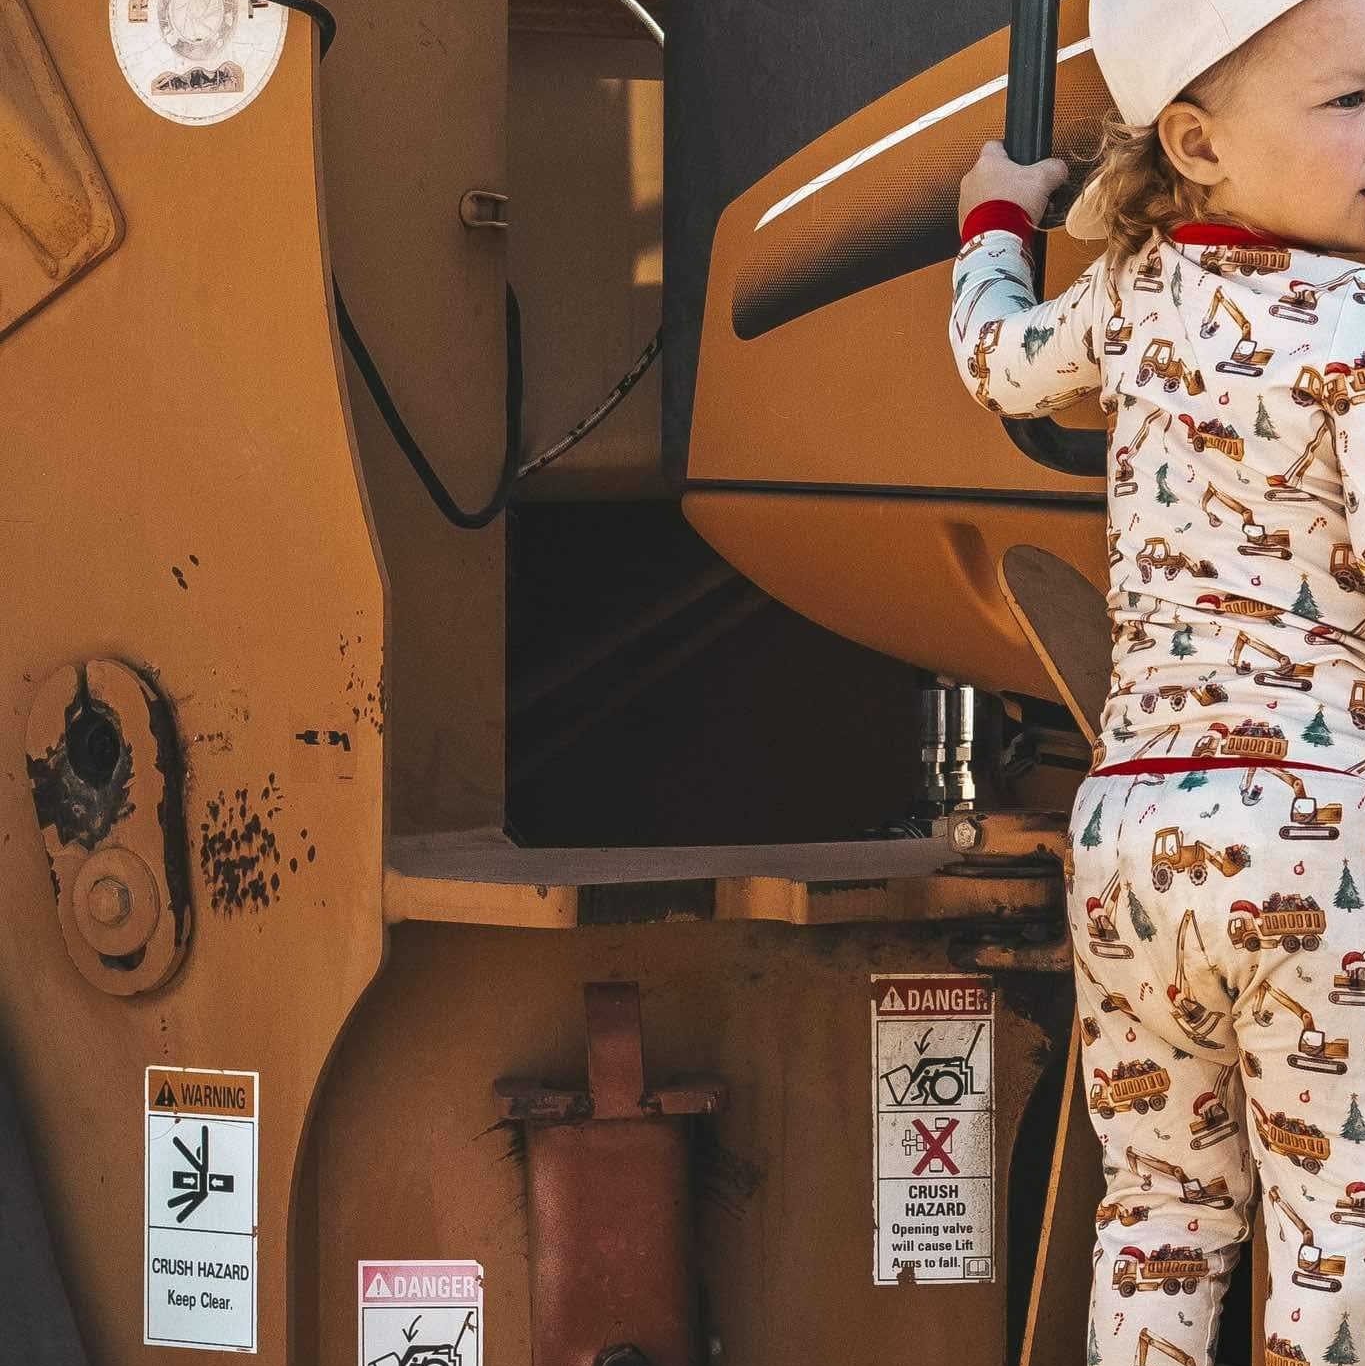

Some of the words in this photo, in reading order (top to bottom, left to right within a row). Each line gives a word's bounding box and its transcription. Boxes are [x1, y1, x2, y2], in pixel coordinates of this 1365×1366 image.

[907, 988, 988, 1011] DANGER
[181, 1083, 246, 1110] WARNING
[908, 1185, 959, 1199] CRUSH
[905, 1202, 966, 1217] HAZARD
[891, 1223, 940, 1237] Opening
[942, 1222, 973, 1234] valve
[892, 1240, 914, 1251] will
[918, 1242, 952, 1251] cause
[955, 1239, 974, 1251] Lift
[151, 1257, 194, 1278] CRUSH
[197, 1260, 250, 1281] HAZARD
[892, 1257, 921, 1269] Arms
[924, 1258, 935, 1268] to
[939, 1256, 961, 1268] fall.
[394, 1275, 475, 1298] DANGER
[167, 1288, 197, 1311] Keep
[200, 1290, 233, 1311] Clear.
